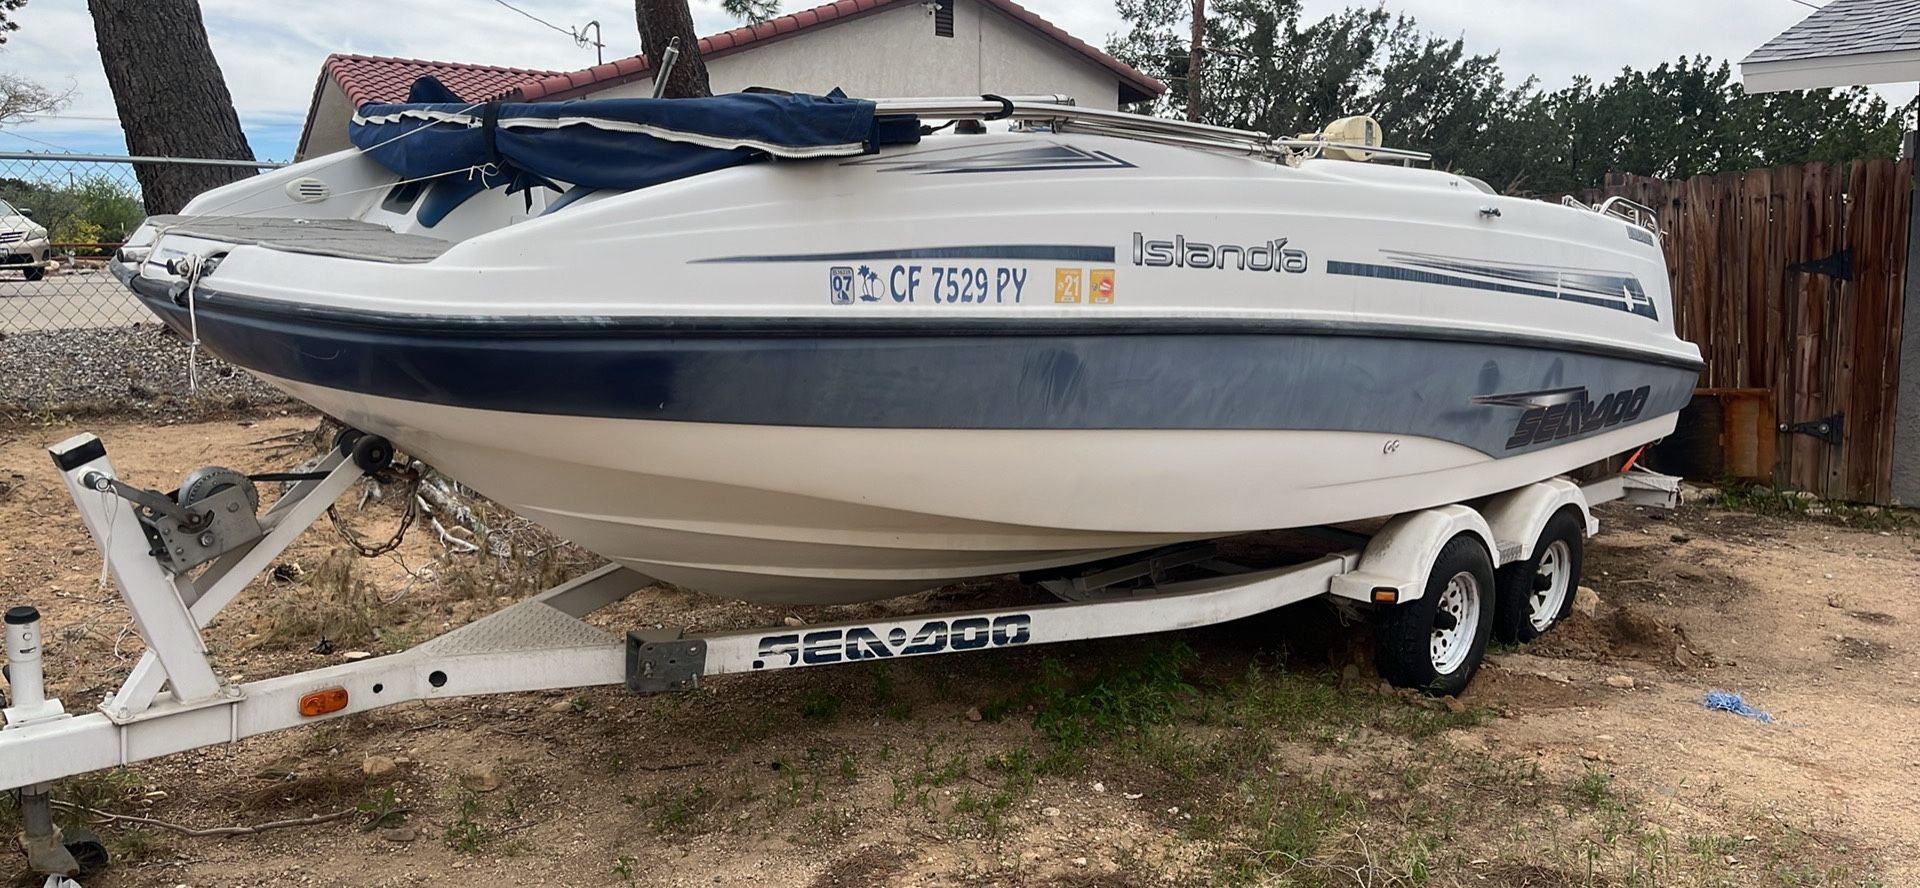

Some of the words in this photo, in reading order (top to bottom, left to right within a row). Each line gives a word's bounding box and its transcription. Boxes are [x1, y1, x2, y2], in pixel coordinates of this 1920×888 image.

[833, 275, 852, 292] 07
[889, 264, 922, 303] CF
[931, 267, 988, 304] 7529
[996, 267, 1027, 303] PY
[1063, 274, 1080, 297] 21
